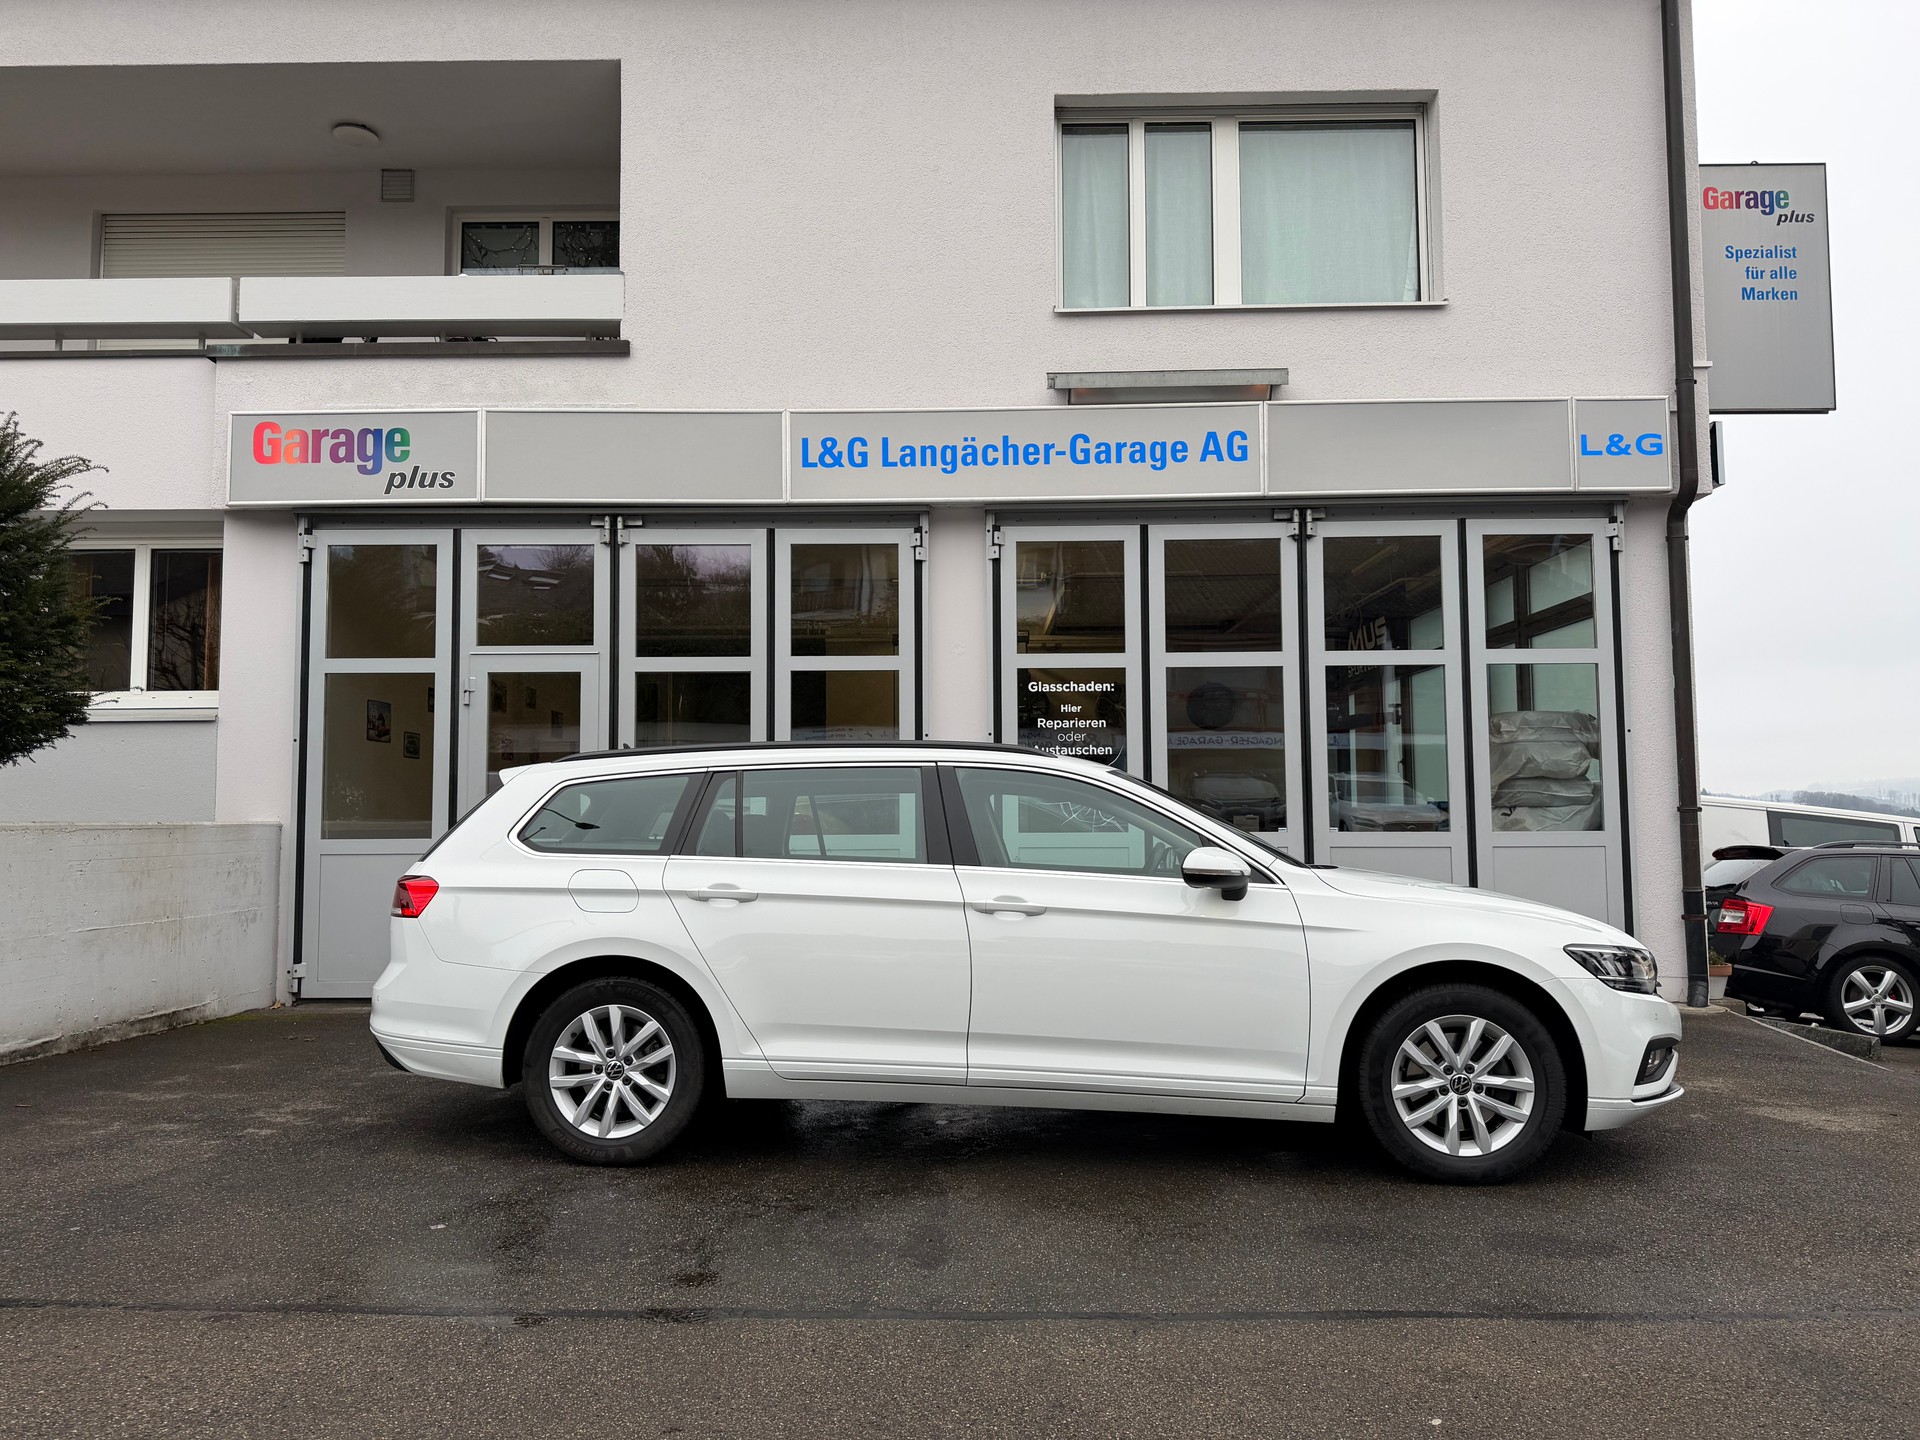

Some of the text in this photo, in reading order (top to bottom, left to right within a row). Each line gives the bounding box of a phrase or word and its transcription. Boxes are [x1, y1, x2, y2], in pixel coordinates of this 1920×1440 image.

[1703, 186, 1790, 216] Garage
[1776, 210, 1815, 226] plus
[1724, 245, 1797, 262] Spezialist
[1744, 266, 1798, 280] für alle
[1741, 287, 1798, 301] Marken
[253, 421, 410, 475] Garage
[801, 430, 1249, 474] L&G Langächer-Garage AG
[1580, 433, 1663, 456] L&G
[384, 465, 456, 495] plus
[1027, 681, 1115, 693] Glasschaden:
[1060, 704, 1082, 713] Hier
[1037, 718, 1107, 730] Reparieren
[1057, 731, 1087, 742] oder
